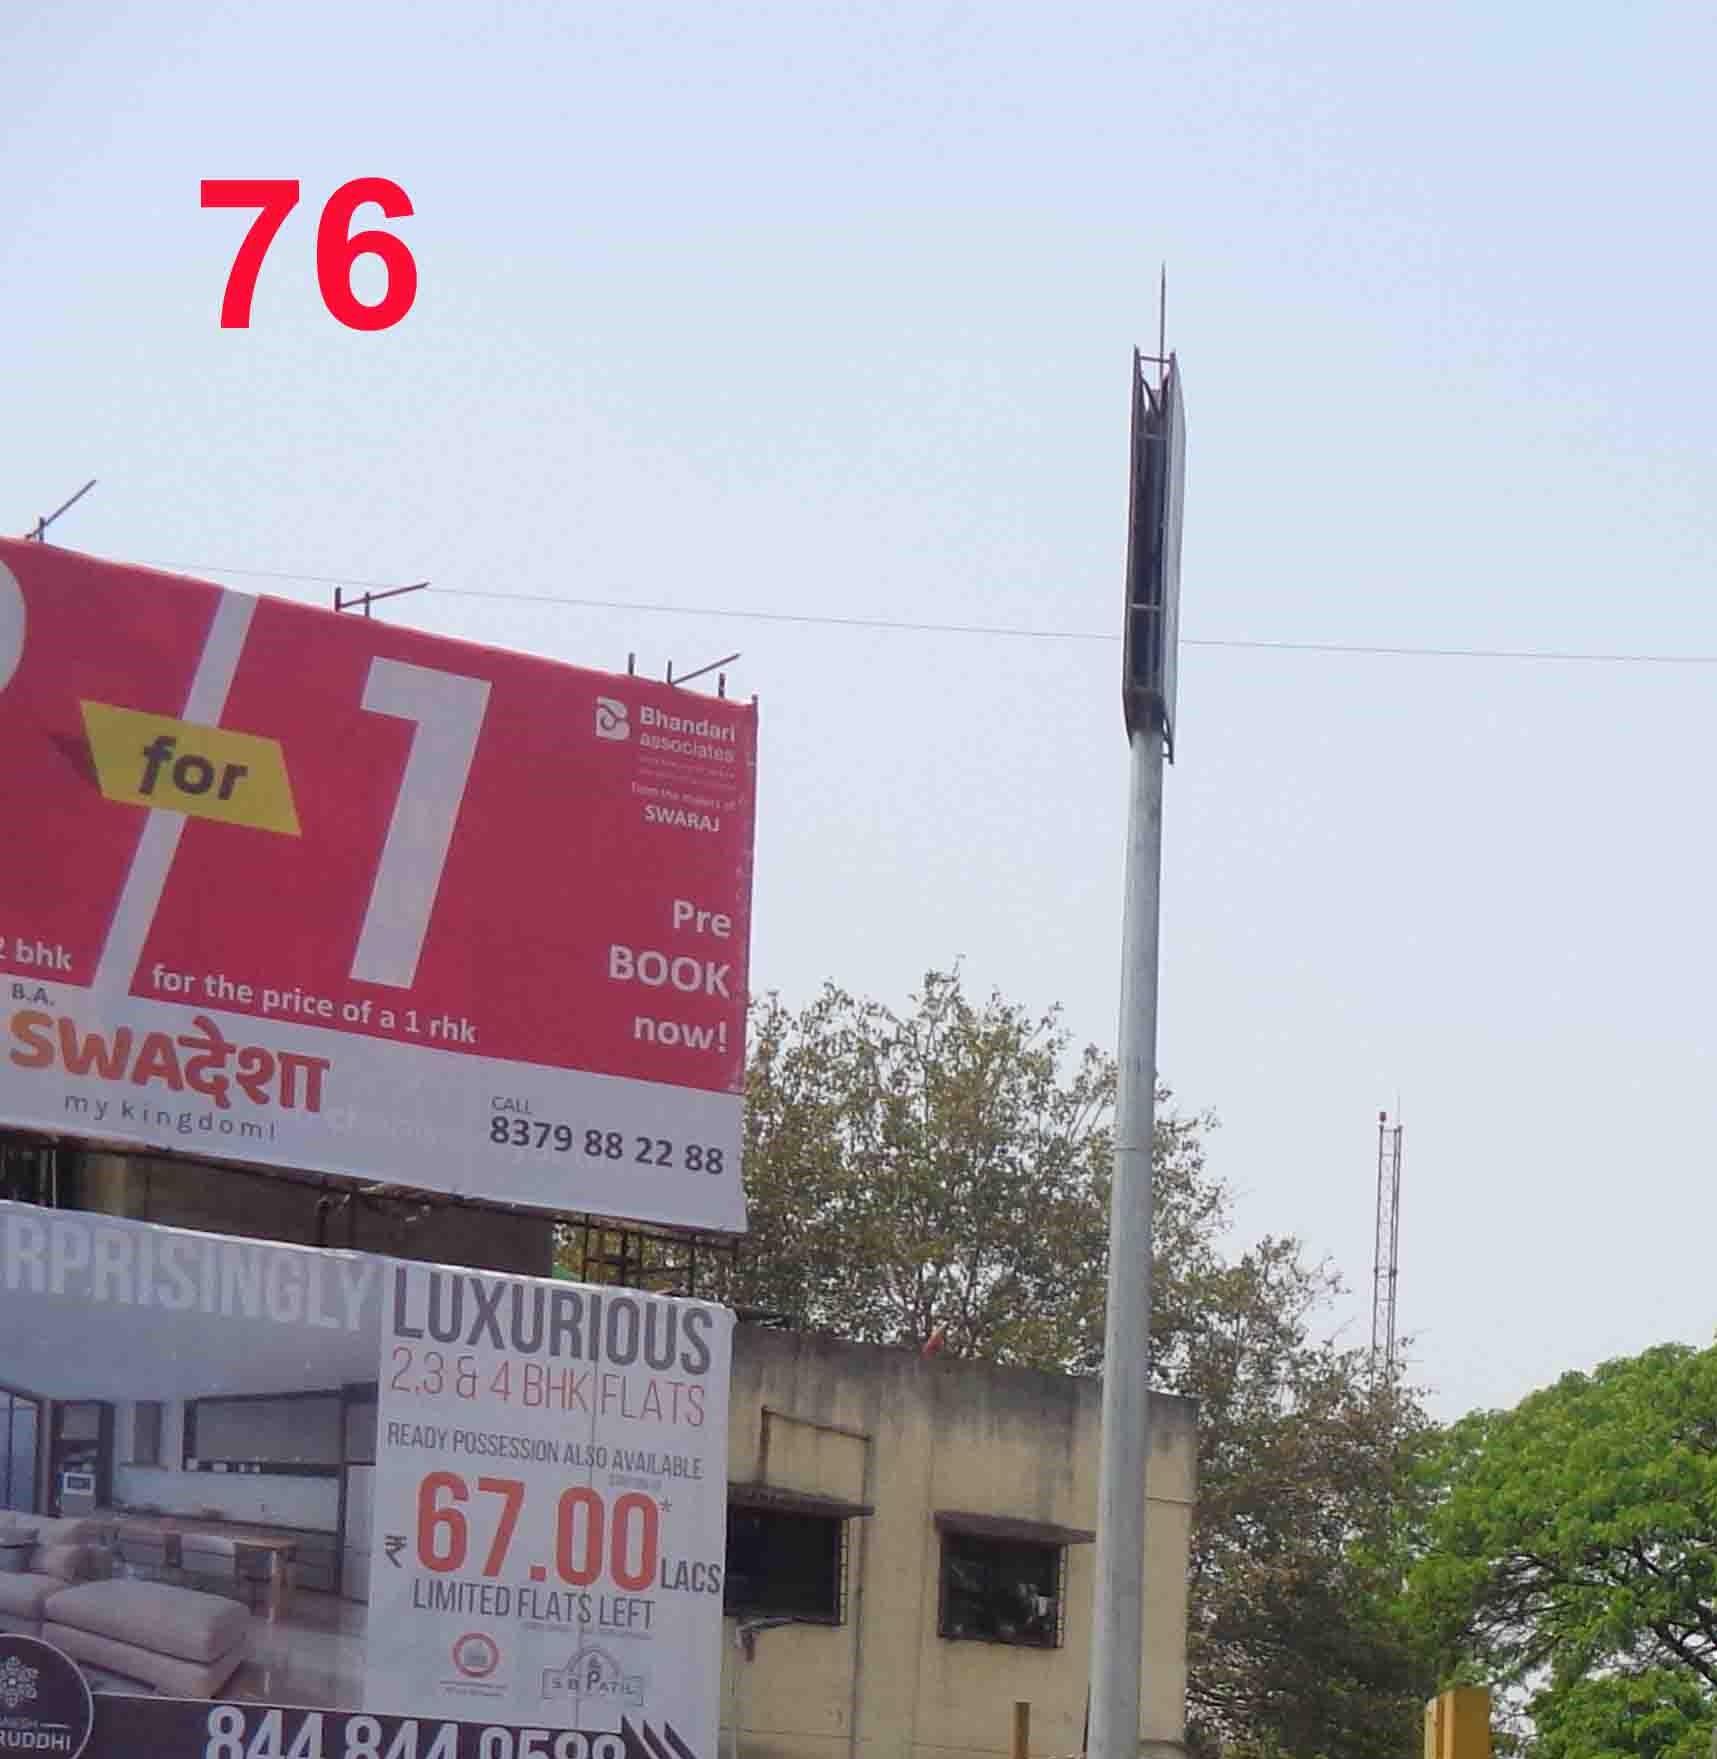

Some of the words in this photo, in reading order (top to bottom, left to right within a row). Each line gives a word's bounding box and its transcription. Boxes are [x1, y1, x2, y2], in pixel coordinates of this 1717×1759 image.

[639, 705, 736, 743] Bhandari
[138, 735, 249, 801] for
[644, 804, 721, 833] SWARAJ
[672, 899, 732, 939] Pre
[16, 936, 72, 972] bhk
[152, 963, 196, 994] for
[204, 973, 253, 1003] the
[262, 986, 334, 1018] price
[342, 1000, 373, 1025] of
[380, 1009, 395, 1030] a
[405, 1009, 421, 1034] 1
[429, 1017, 477, 1044] rhk
[608, 943, 730, 999] BOOK
[11, 983, 55, 1007] B.A.
[634, 1015, 729, 1054] now!
[64, 1094, 109, 1121] my
[491, 1096, 532, 1114] CALL
[490, 1115, 573, 1153] 8379
[583, 1129, 623, 1160] 88
[634, 1136, 673, 1168] 22
[685, 1144, 724, 1176] 88
[393, 1265, 713, 1376] LUXURIOUS
[456, 1355, 479, 1400] &
[490, 1360, 513, 1401] 4
[523, 1362, 588, 1414] BHK
[601, 1373, 705, 1427] FLATS
[388, 1421, 448, 1450] READY
[453, 1431, 559, 1463] POSSESSION
[564, 1443, 607, 1468] ALSO
[611, 1449, 703, 1480] AVAILABLE
[660, 1556, 722, 1595] LACS
[413, 1578, 510, 1617] LIMITED
[518, 1587, 592, 1624] FLATS
[599, 1595, 656, 1630] LEFT
